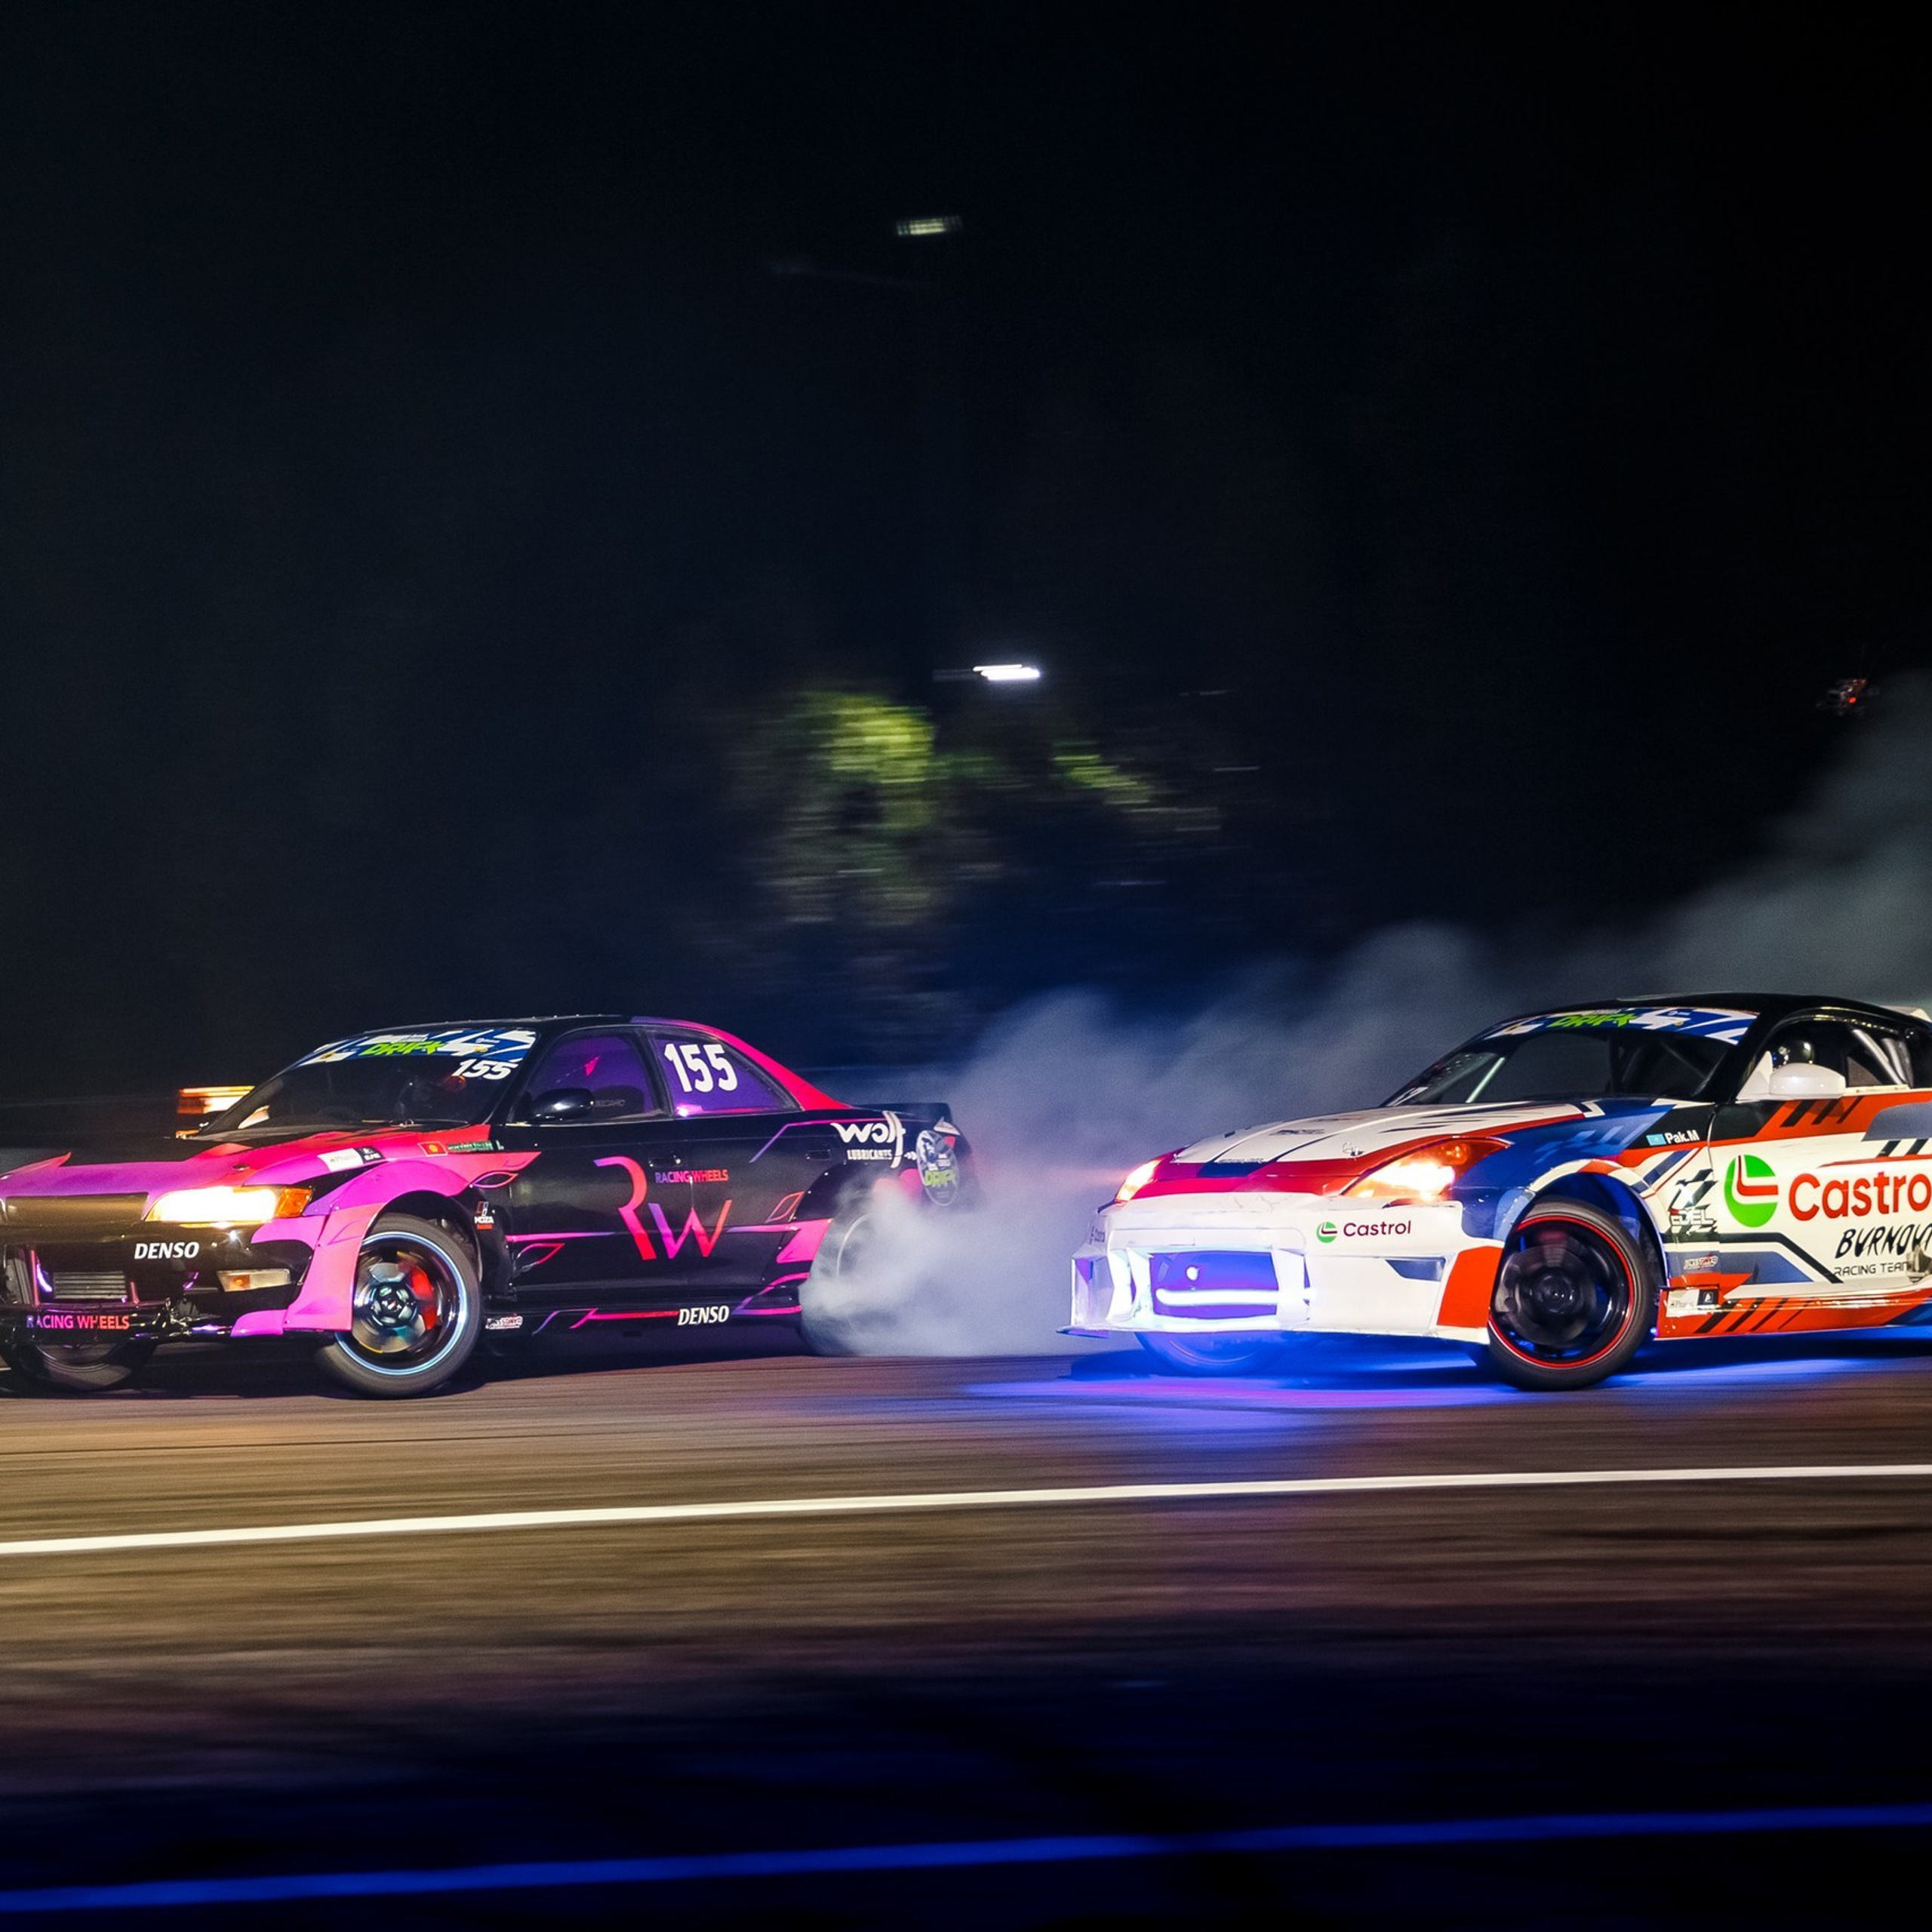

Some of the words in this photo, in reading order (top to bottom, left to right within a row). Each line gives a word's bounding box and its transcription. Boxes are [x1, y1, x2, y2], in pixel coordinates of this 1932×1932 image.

[452, 1059, 518, 1079] 155
[664, 1043, 738, 1092] 155
[1664, 1130, 1700, 1144] Pak.M
[847, 1149, 892, 1161] LUBRICANTS
[654, 1171, 690, 1184] RACING
[691, 1169, 729, 1183] WHEELS
[1343, 1220, 1411, 1237] Castrol
[134, 1242, 199, 1260] DENSO
[1834, 1264, 1877, 1277] RACING
[26, 1315, 74, 1329] RACING
[77, 1315, 130, 1330] WHEELS
[678, 1306, 729, 1326] DENSO
